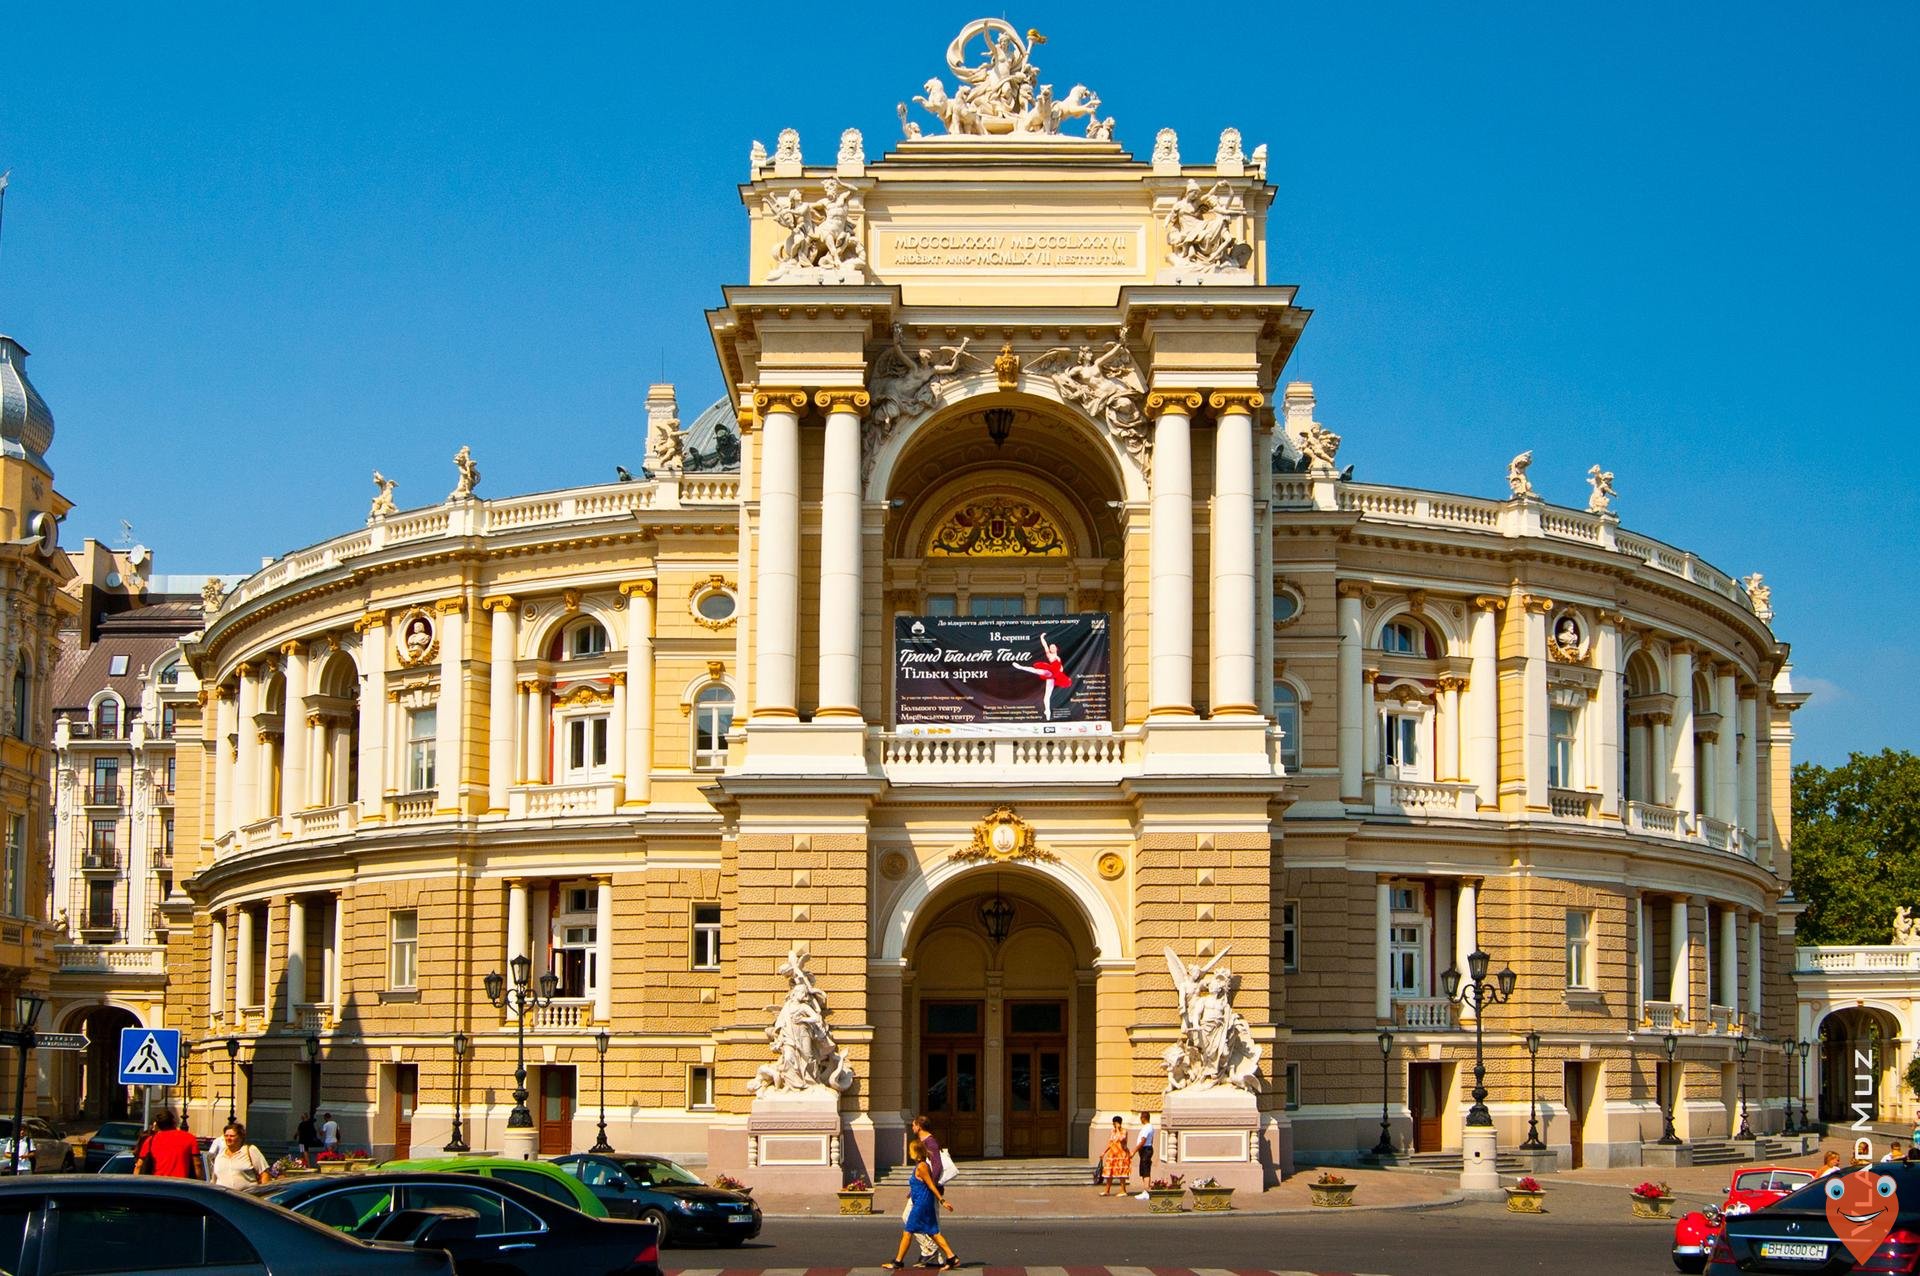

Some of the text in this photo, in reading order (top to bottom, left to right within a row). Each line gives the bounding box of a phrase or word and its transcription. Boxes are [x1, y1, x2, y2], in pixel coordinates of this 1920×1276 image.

[989, 632, 1030, 643] 18 серпня
[900, 648, 1033, 664] Гранд Балет Гала
[901, 667, 989, 682] Тільки зірки
[901, 704, 963, 713] Большого театру
[951, 714, 975, 722] театру
[1768, 1243, 1825, 1256] BH 0600 CH
